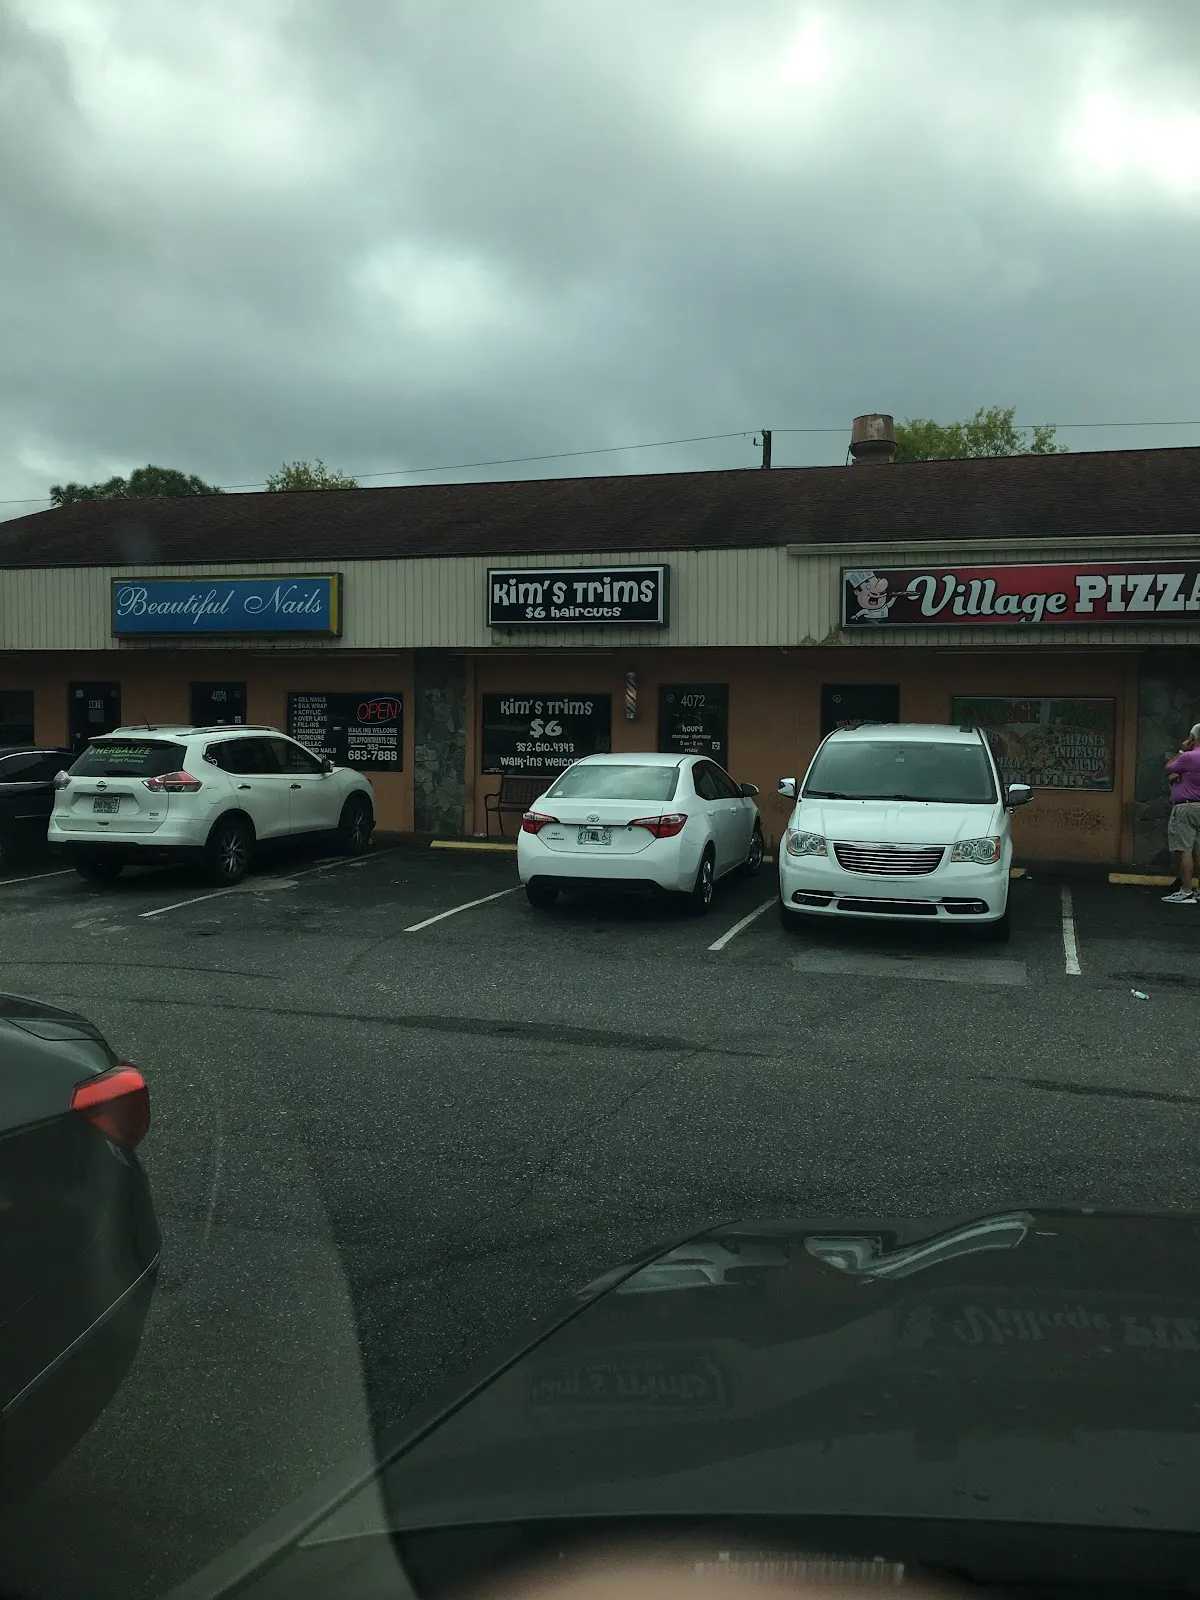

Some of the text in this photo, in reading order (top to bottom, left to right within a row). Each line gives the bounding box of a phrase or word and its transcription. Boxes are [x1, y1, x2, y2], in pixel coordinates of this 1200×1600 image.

[493, 577, 656, 606] Kim's Trims
[116, 584, 323, 624] Beautiful Nails
[906, 575, 1068, 623] Village
[525, 605, 622, 618] $6 haircuts
[500, 698, 594, 715] Kim's Trims
[680, 694, 706, 707] 4072
[357, 702, 398, 720] OPEN
[529, 718, 563, 738] $6
[1059, 733, 1105, 746] CALZONES
[95, 747, 152, 755] HERBALIFE
[347, 750, 398, 761] 683-7888
[1054, 746, 1106, 759] ANTIPASTO
[1067, 758, 1105, 771] SALADS
